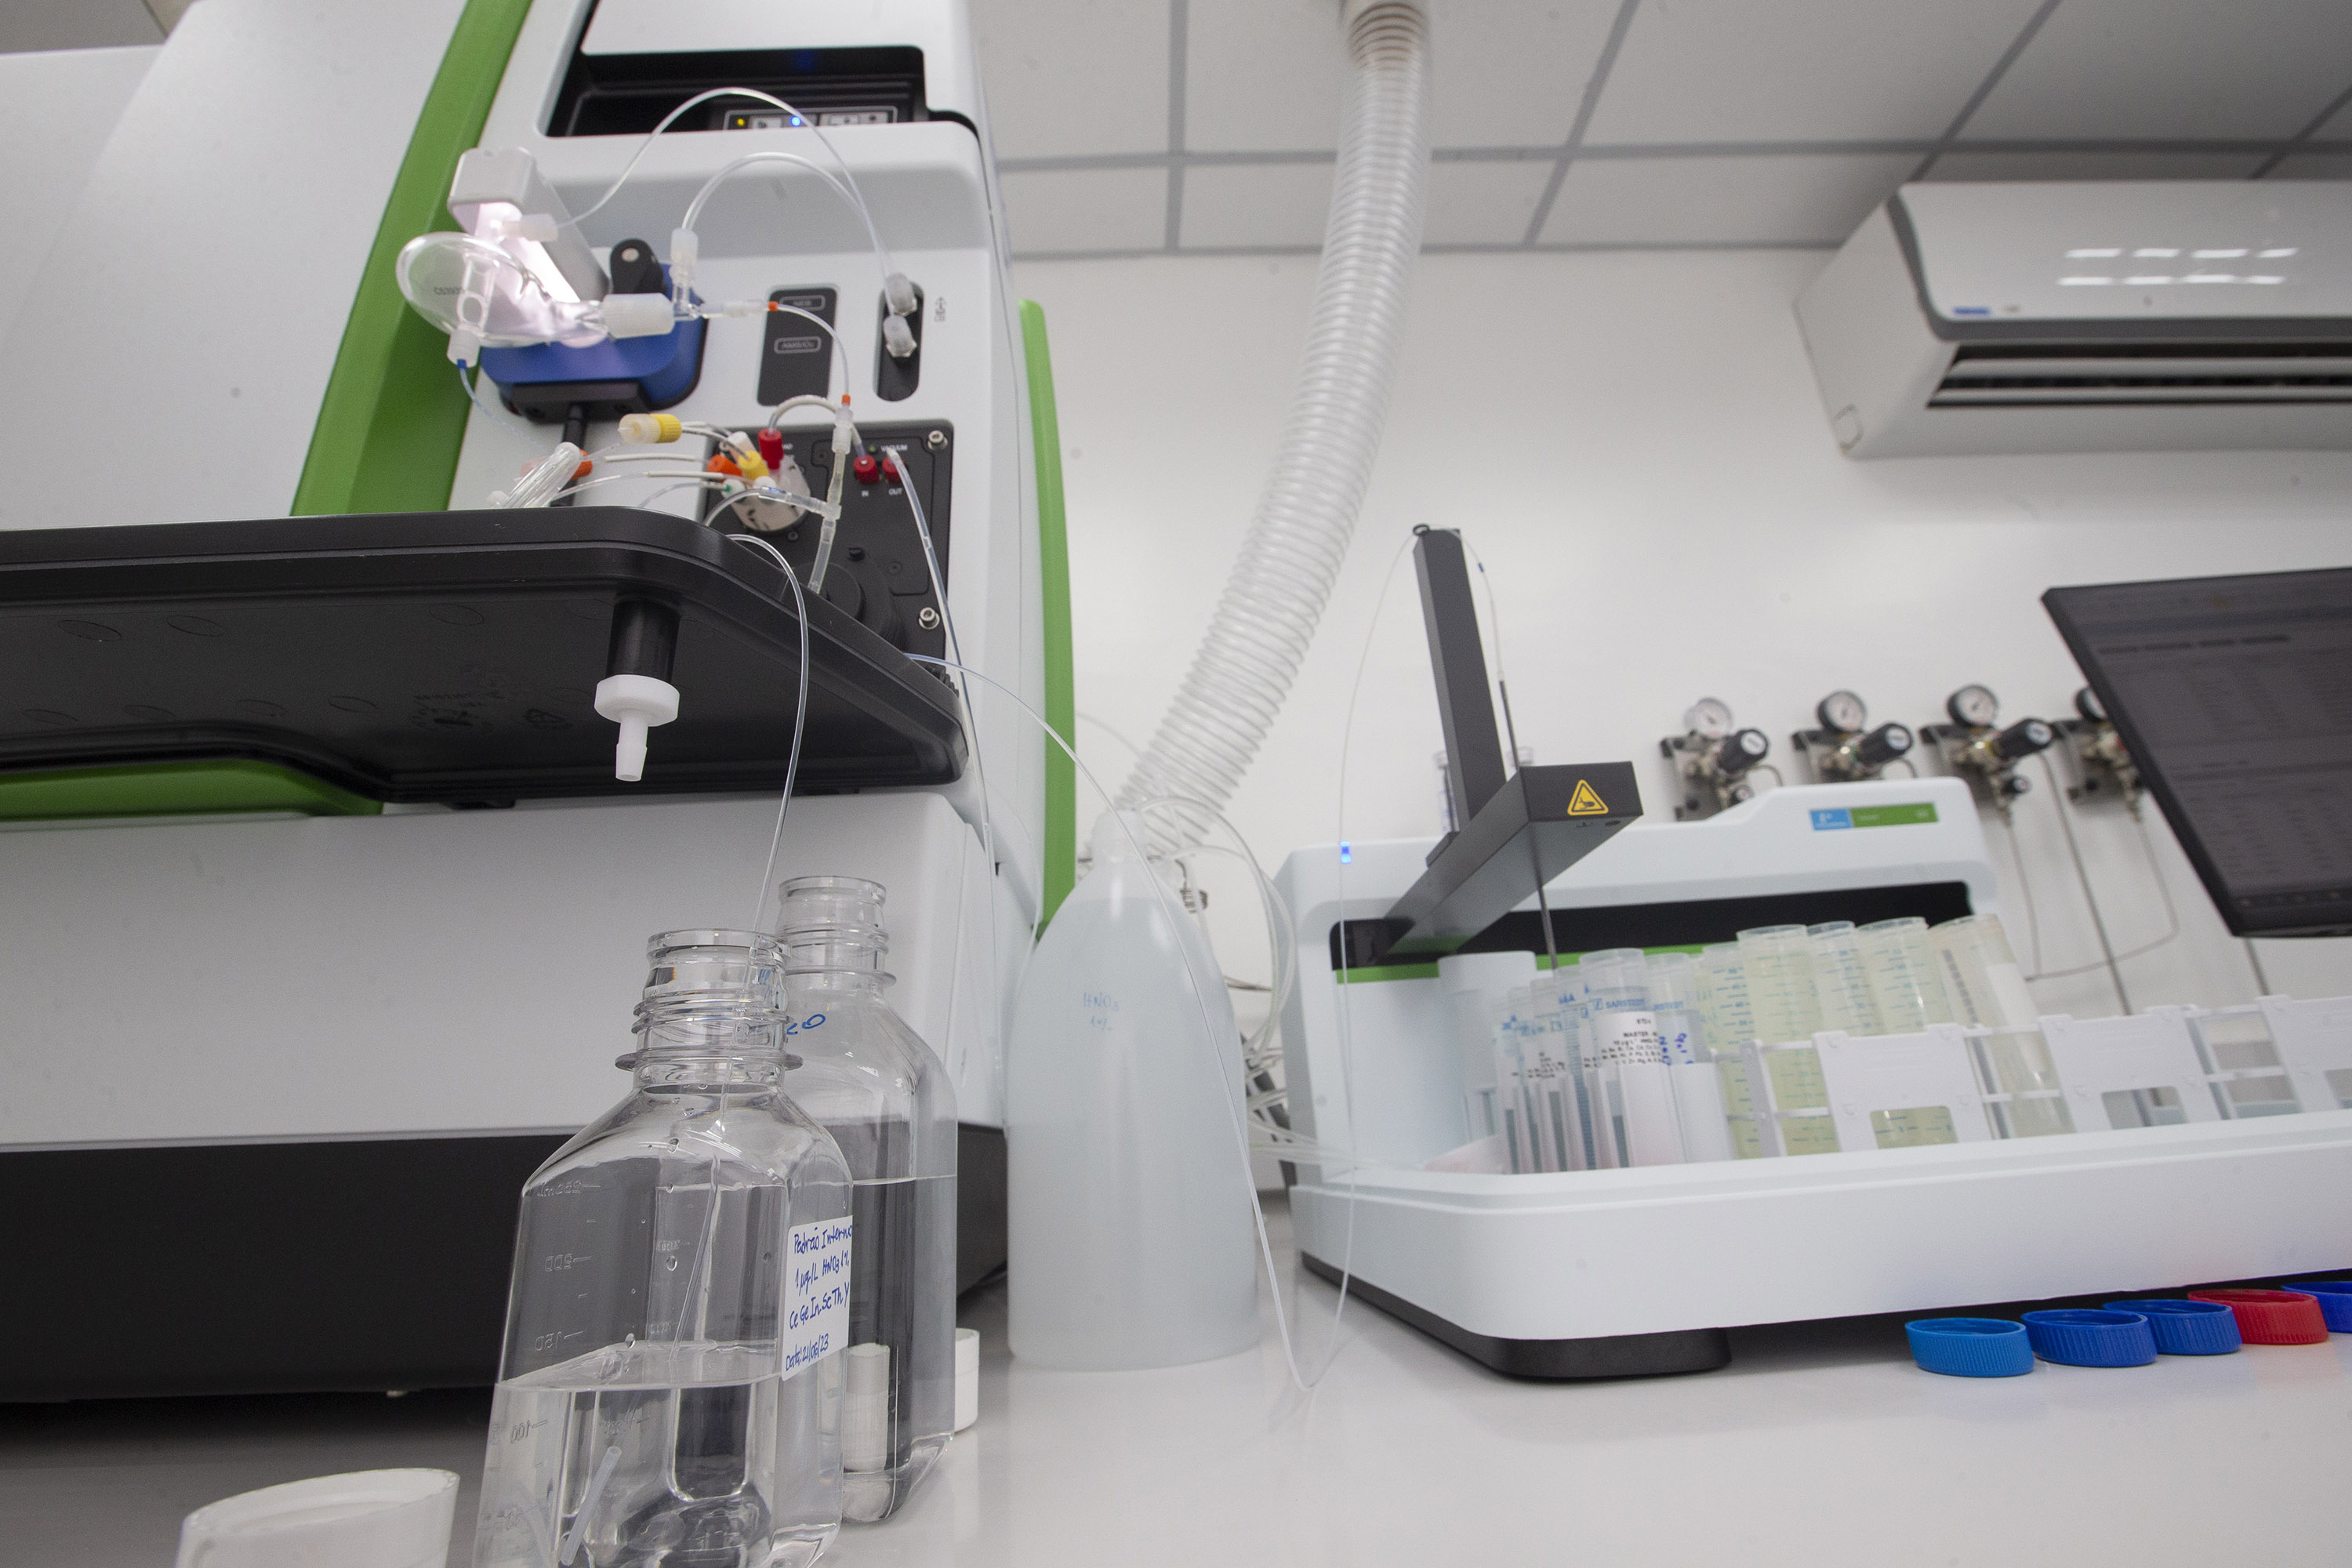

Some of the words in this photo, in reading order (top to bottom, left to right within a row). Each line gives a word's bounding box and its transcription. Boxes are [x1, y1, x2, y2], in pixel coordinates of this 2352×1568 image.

[880, 444, 908, 452] VACUUM
[888, 488, 902, 496] OUT
[793, 1227, 819, 1254] Padrão
